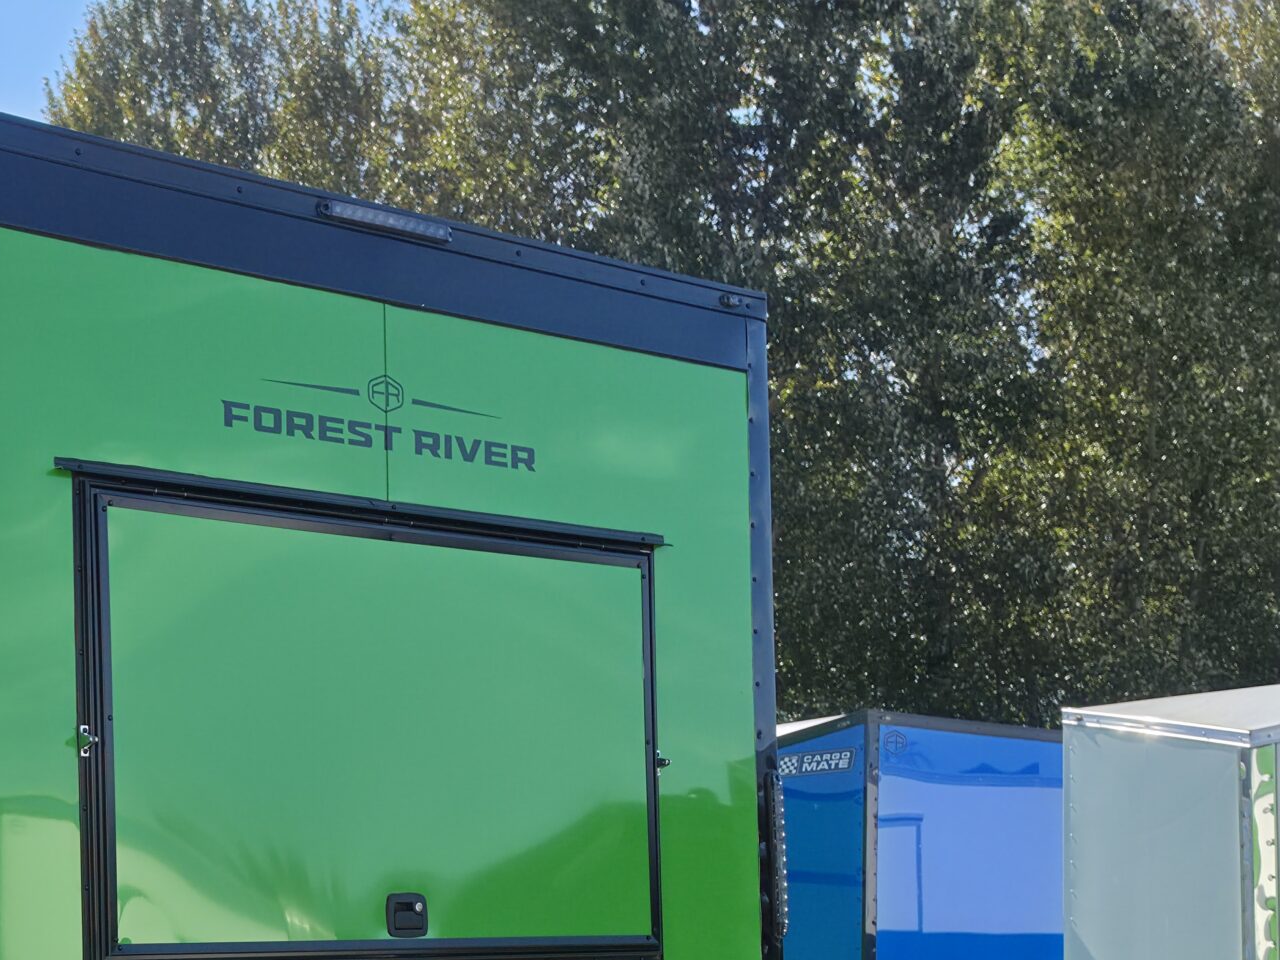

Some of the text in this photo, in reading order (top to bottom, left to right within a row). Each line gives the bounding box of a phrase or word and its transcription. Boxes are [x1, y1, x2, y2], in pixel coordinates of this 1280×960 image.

[221, 399, 536, 472] FOREST RIVER
[804, 752, 850, 763] CARGO
[802, 760, 849, 772] MATE
